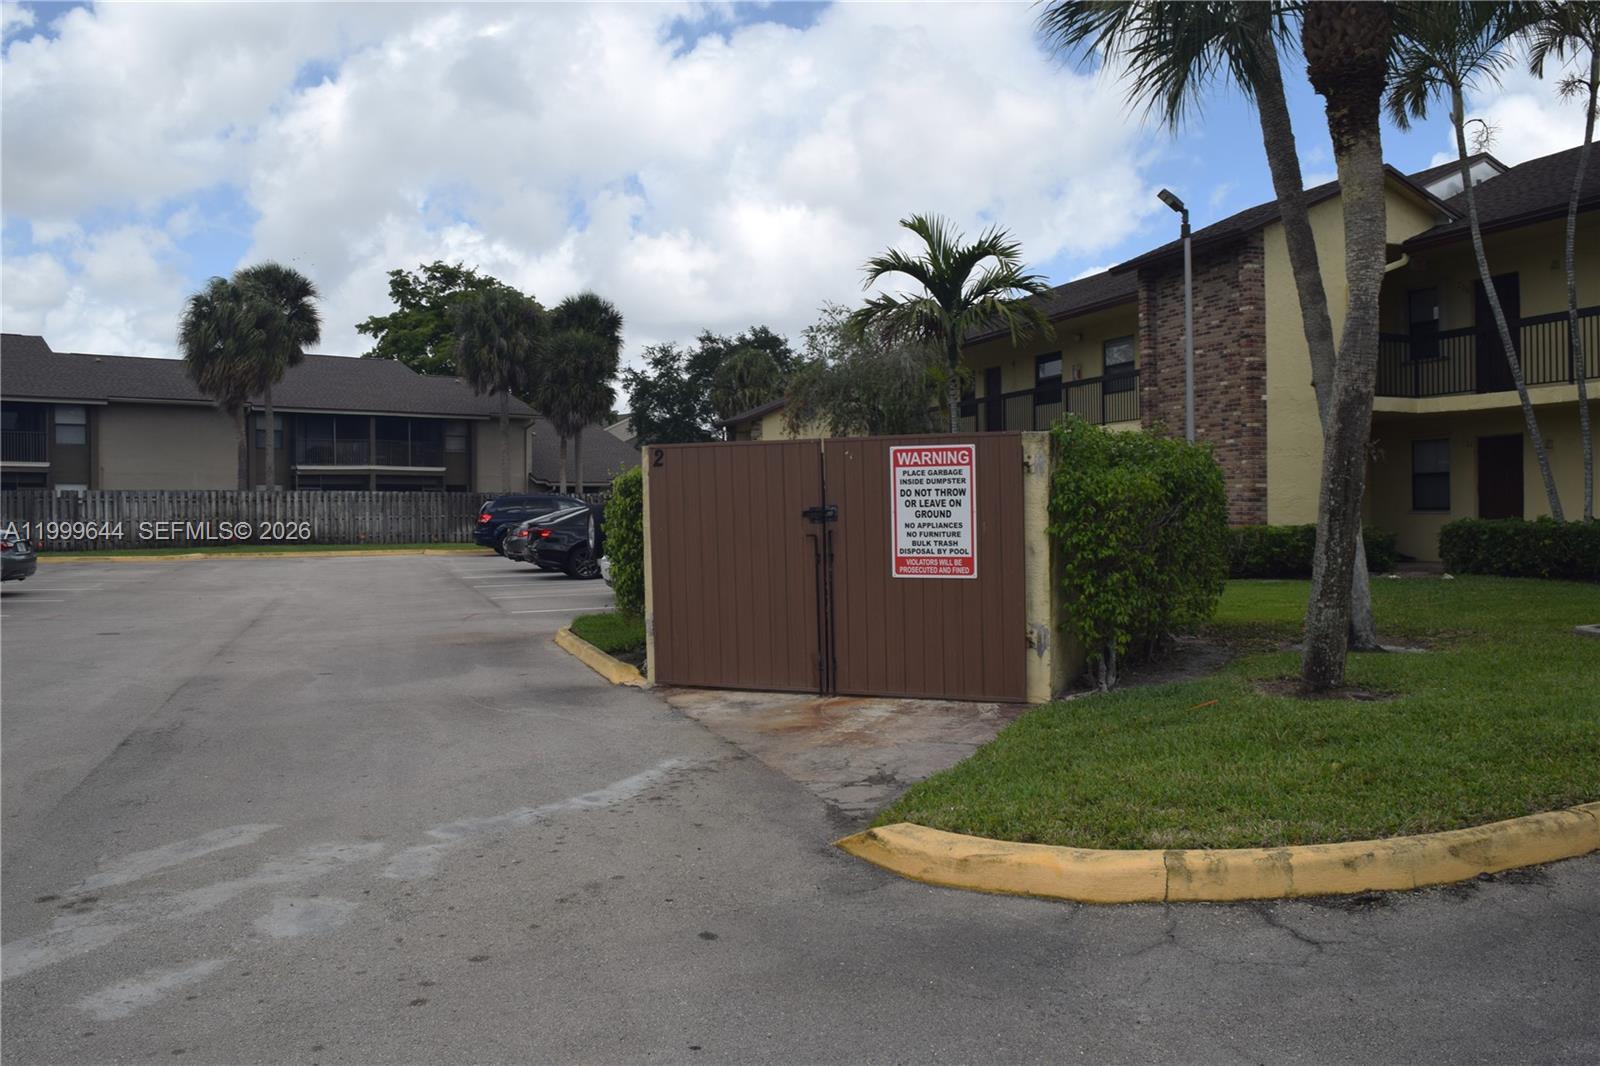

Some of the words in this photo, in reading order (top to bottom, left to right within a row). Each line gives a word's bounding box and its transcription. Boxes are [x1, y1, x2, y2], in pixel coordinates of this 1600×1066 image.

[653, 449, 664, 467] 2
[896, 450, 970, 465] WARNING
[900, 489, 912, 497] DO
[914, 488, 932, 497] NOT
[934, 488, 967, 497] THROW
[904, 500, 917, 508] OR
[919, 499, 947, 508] LEAVE
[948, 499, 962, 508] ON
[914, 510, 952, 519] GROUND
[905, 558, 939, 566] VIOLATORS
[939, 558, 953, 566] WILL
[953, 558, 962, 566] BE
